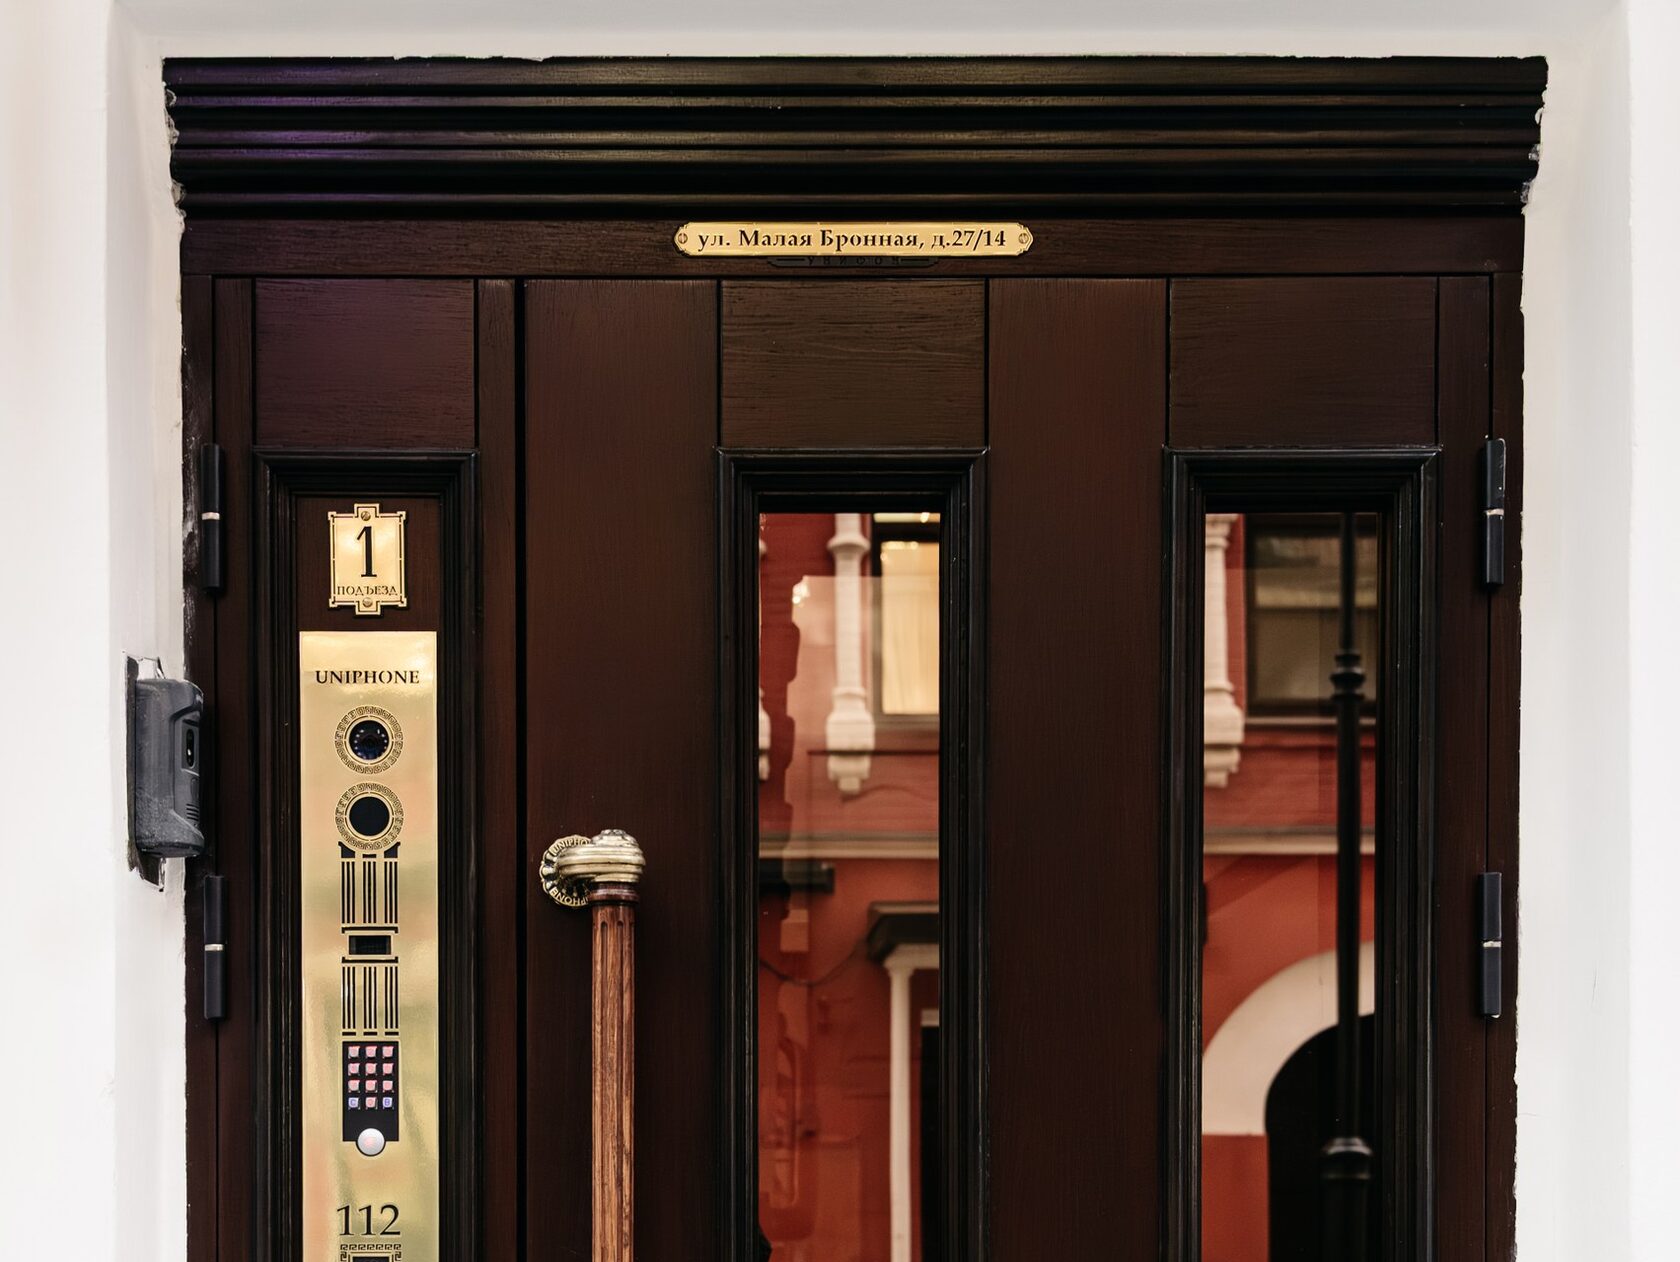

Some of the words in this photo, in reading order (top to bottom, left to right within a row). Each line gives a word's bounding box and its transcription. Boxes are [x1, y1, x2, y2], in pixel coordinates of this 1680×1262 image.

[697, 234, 731, 251] ул.
[739, 229, 812, 247] Малая
[820, 229, 924, 251] Бронная,
[931, 229, 1006, 251] д.27/14
[356, 525, 378, 578] 1
[337, 585, 398, 597] ПОДЪЕЗД
[315, 670, 420, 684] UNIPHONE
[336, 1204, 401, 1236] 112
